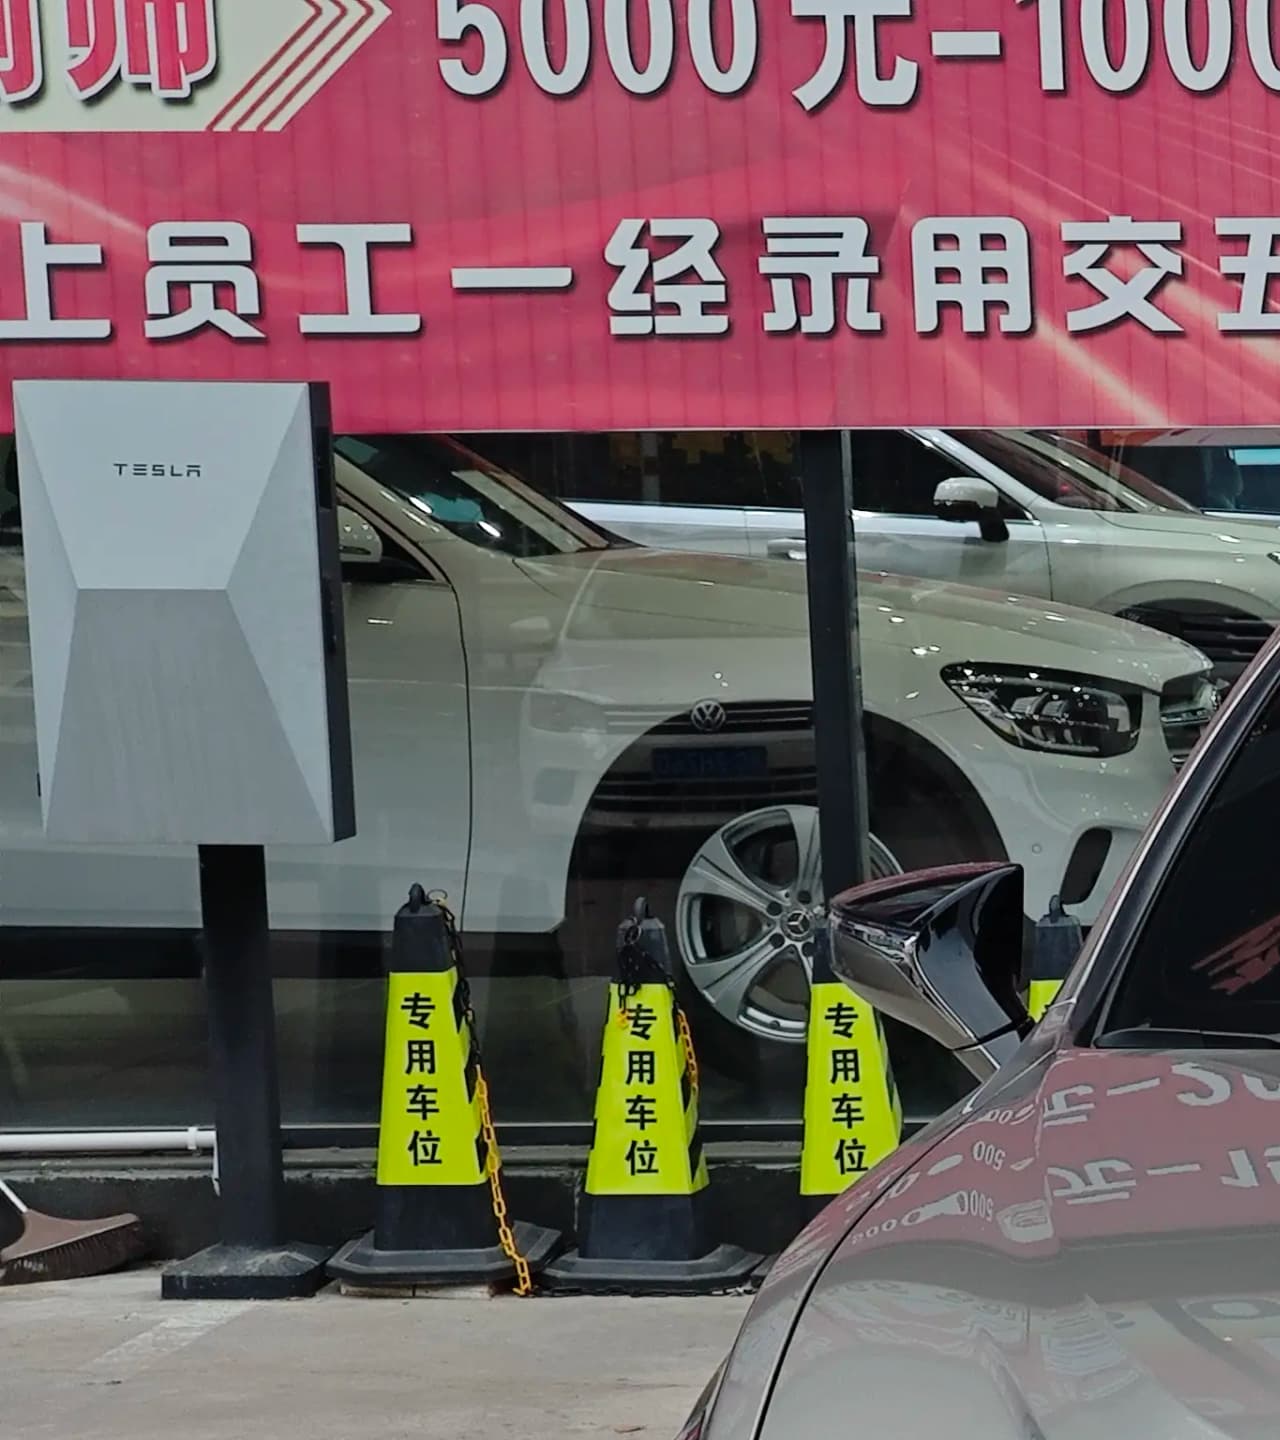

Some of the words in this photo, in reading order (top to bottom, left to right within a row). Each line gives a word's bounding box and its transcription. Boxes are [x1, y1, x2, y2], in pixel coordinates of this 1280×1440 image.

[113, 463, 202, 478] TESLA
[401, 991, 443, 1168] 专用车位
[624, 1003, 660, 1177] 专用车位
[824, 1002, 869, 1176] 专用车位
